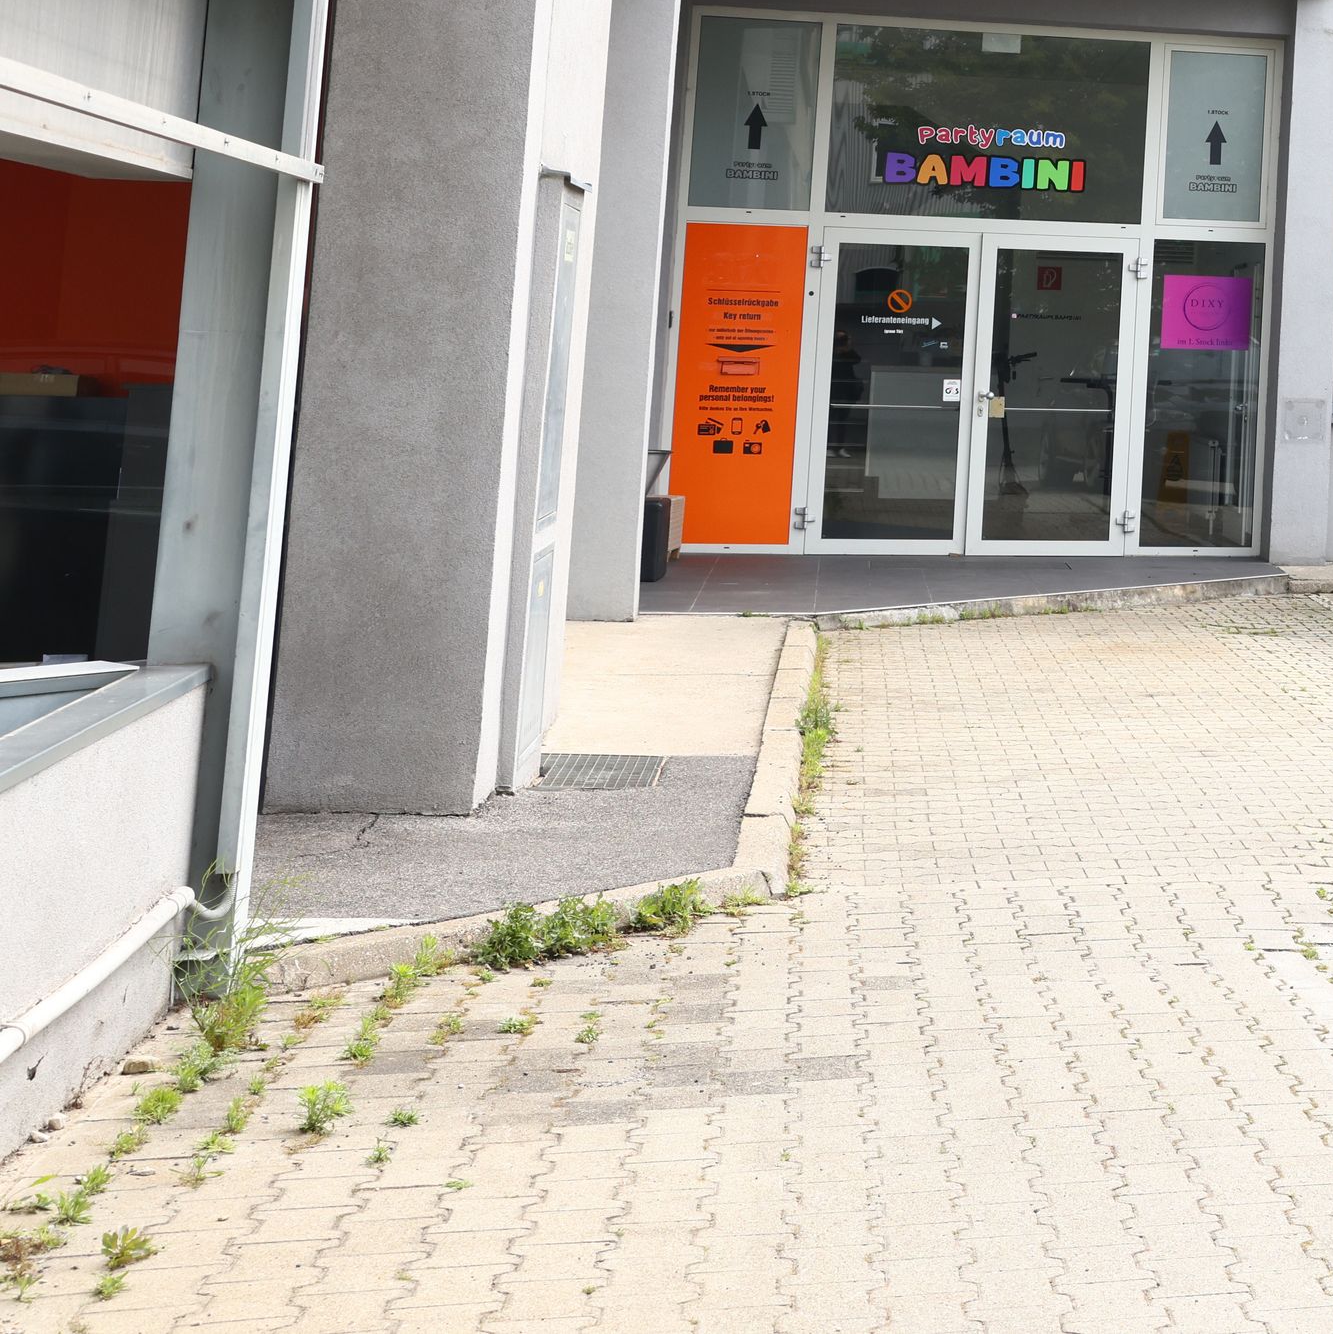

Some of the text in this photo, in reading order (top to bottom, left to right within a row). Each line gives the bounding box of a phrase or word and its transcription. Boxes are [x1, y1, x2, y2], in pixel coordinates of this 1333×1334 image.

[917, 124, 1067, 150] Partyraum
[726, 168, 779, 181] BAMBINI
[883, 151, 1087, 193] BAMBINI
[1188, 182, 1238, 193] BAMBINI
[707, 297, 779, 308] Schlüsselrückgabe
[1190, 299, 1224, 308] DIXY
[723, 311, 762, 321] Key return
[861, 315, 930, 326] Lieferanteneingang
[708, 384, 766, 395] Remember your
[699, 393, 775, 404] personal belongings!
